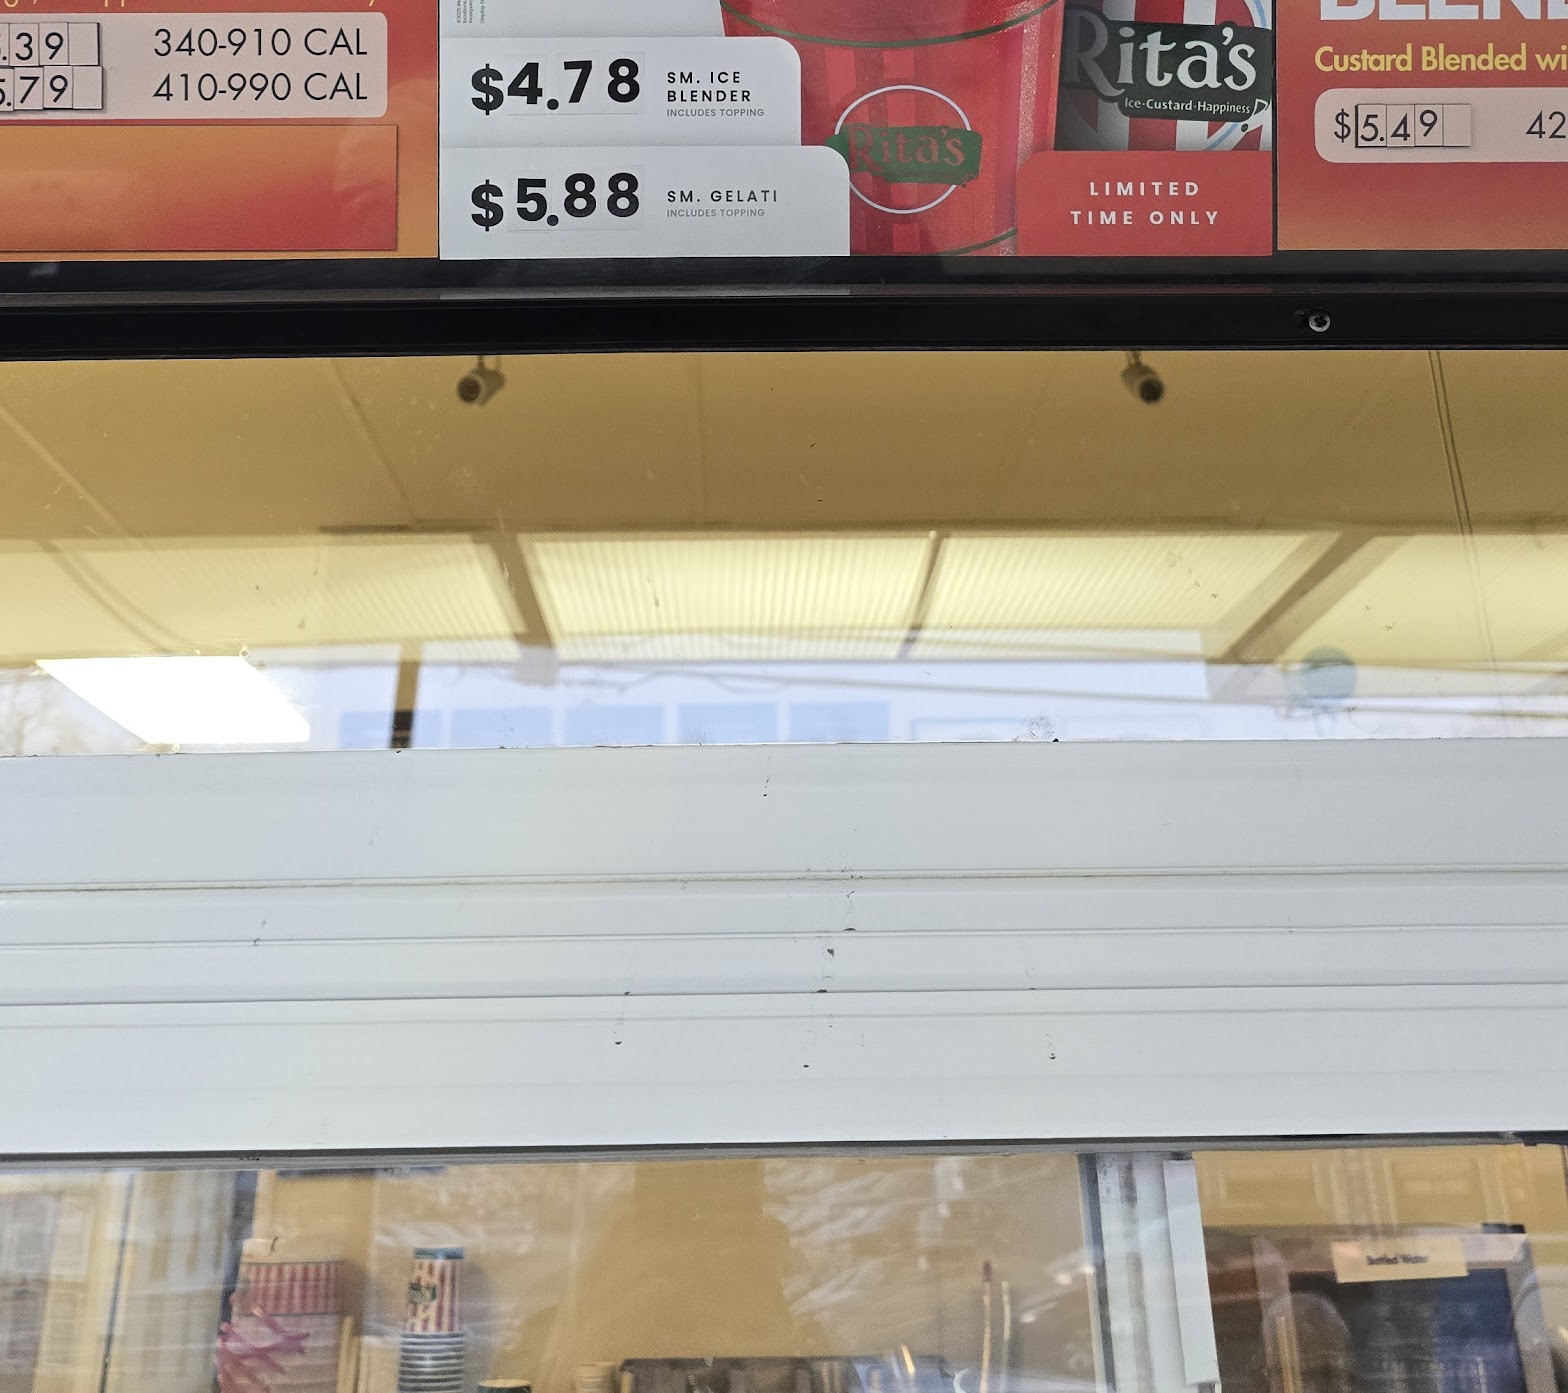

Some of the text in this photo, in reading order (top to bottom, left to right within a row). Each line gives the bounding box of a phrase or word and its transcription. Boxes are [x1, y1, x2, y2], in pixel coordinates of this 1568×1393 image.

[0, 28, 368, 61] .39 340-910 CAL
[1064, 8, 1257, 97] Rita's
[1314, 44, 1412, 72] Custard
[1421, 43, 1528, 71] Blended
[153, 73, 291, 101] 410-990
[304, 73, 368, 101] CAL
[471, 59, 741, 114] $4.78 SM. ICE
[667, 90, 752, 103] BLENDER
[667, 108, 765, 117] INCLUDES TOPPING
[1334, 108, 1438, 143] $5.49
[848, 126, 965, 173] Rita's
[471, 173, 778, 231] $5.88 SM. GELATI
[1090, 182, 1200, 196] LIMITED
[667, 209, 765, 217] INCLUDES TOPPING
[1071, 210, 1219, 225] TIME ONLY
